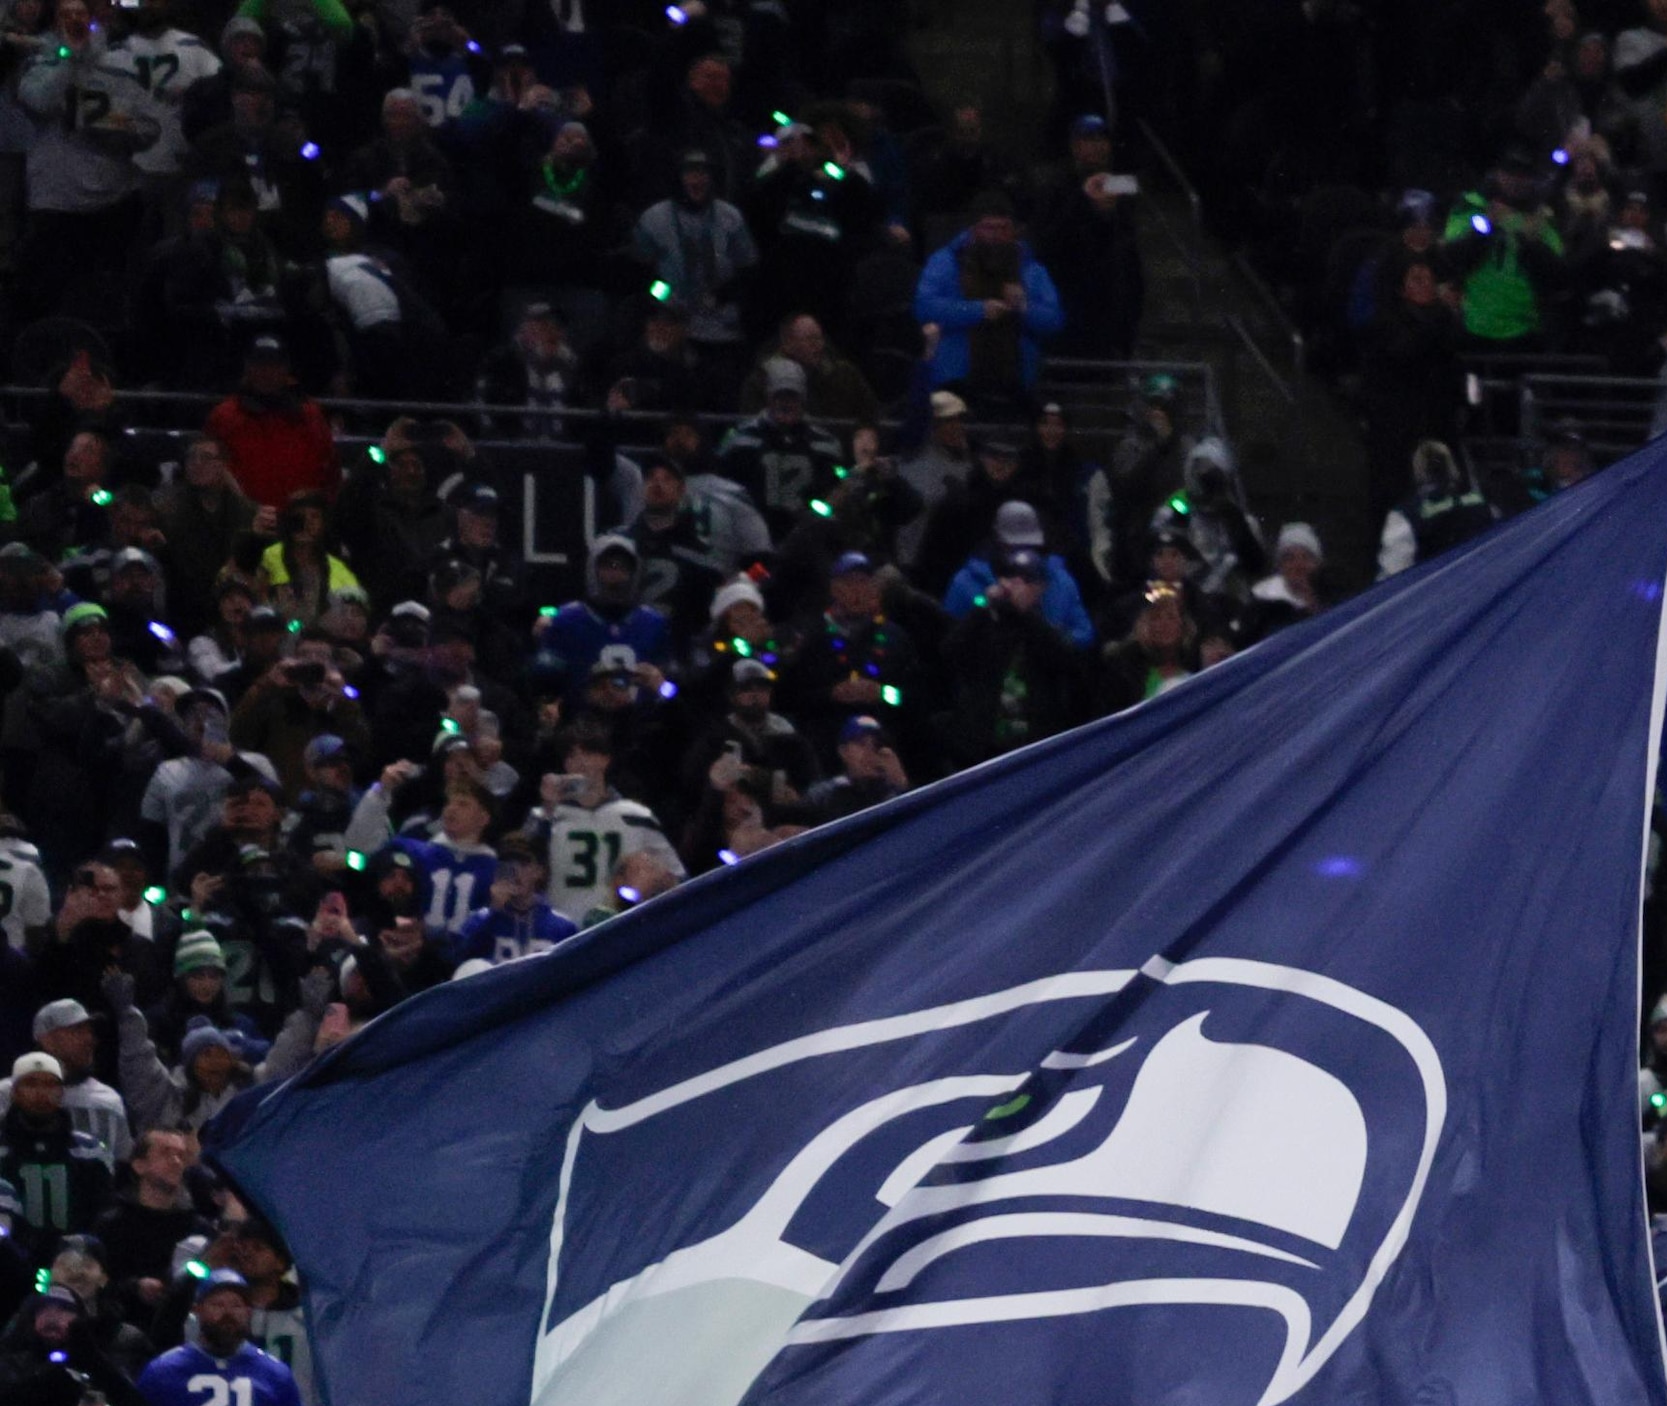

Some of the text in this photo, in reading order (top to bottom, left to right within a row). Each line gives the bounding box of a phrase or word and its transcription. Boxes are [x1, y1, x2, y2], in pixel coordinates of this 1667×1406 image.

[406, 74, 473, 127] 54
[762, 452, 809, 507] 12
[566, 831, 621, 887] 31
[426, 868, 476, 932] 11
[20, 1163, 69, 1231] 11
